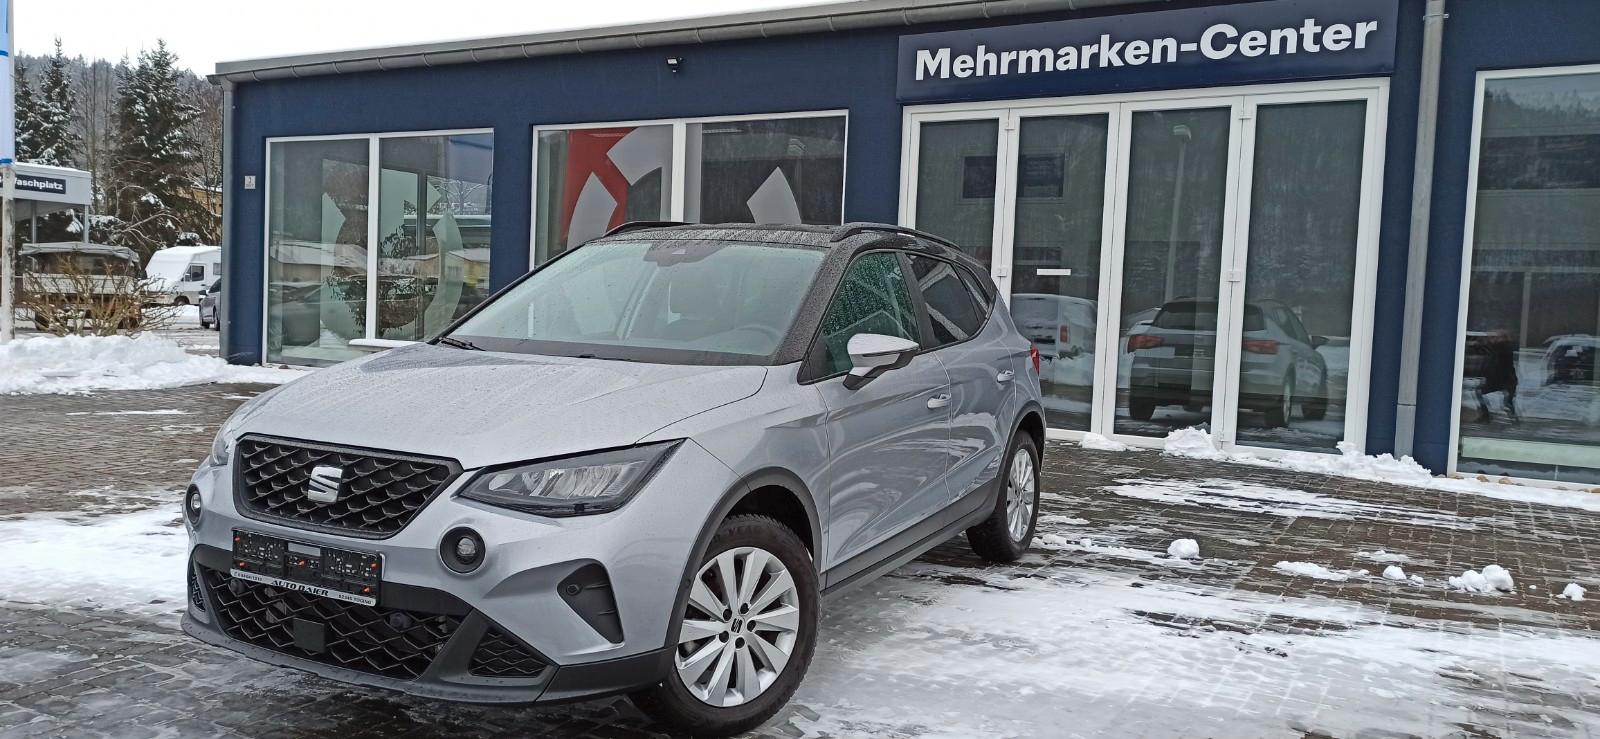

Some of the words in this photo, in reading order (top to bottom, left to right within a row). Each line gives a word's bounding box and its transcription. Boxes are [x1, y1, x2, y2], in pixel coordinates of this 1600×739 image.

[915, 18, 1377, 81] Mehrmarken-Center
[15, 177, 63, 190] aschplatz
[271, 580, 297, 590] AUTO
